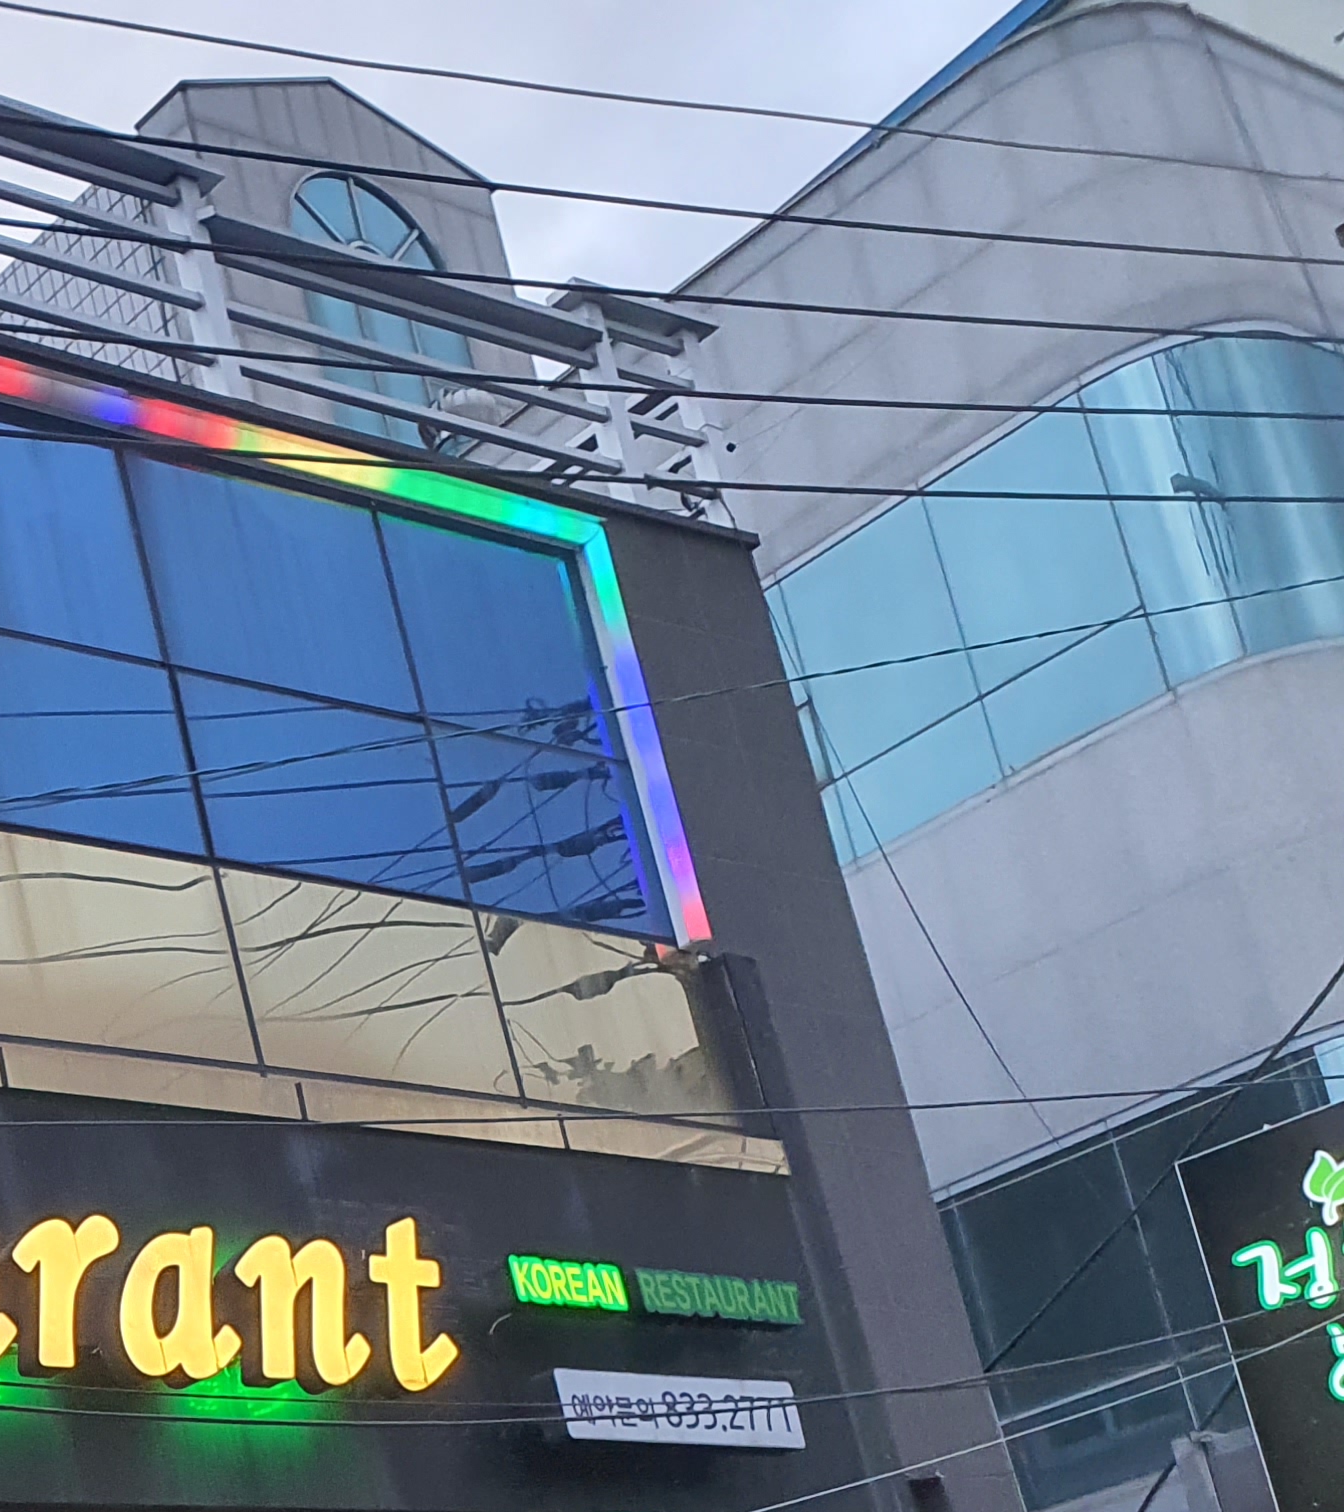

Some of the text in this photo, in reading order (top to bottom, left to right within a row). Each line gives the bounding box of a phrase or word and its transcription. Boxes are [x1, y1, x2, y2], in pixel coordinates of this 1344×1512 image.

[510, 1256, 802, 1323] KOREAN RESTAURANT
[1231, 1226, 1343, 1310] 정
[662, 1390, 793, 1432] 833.2777
